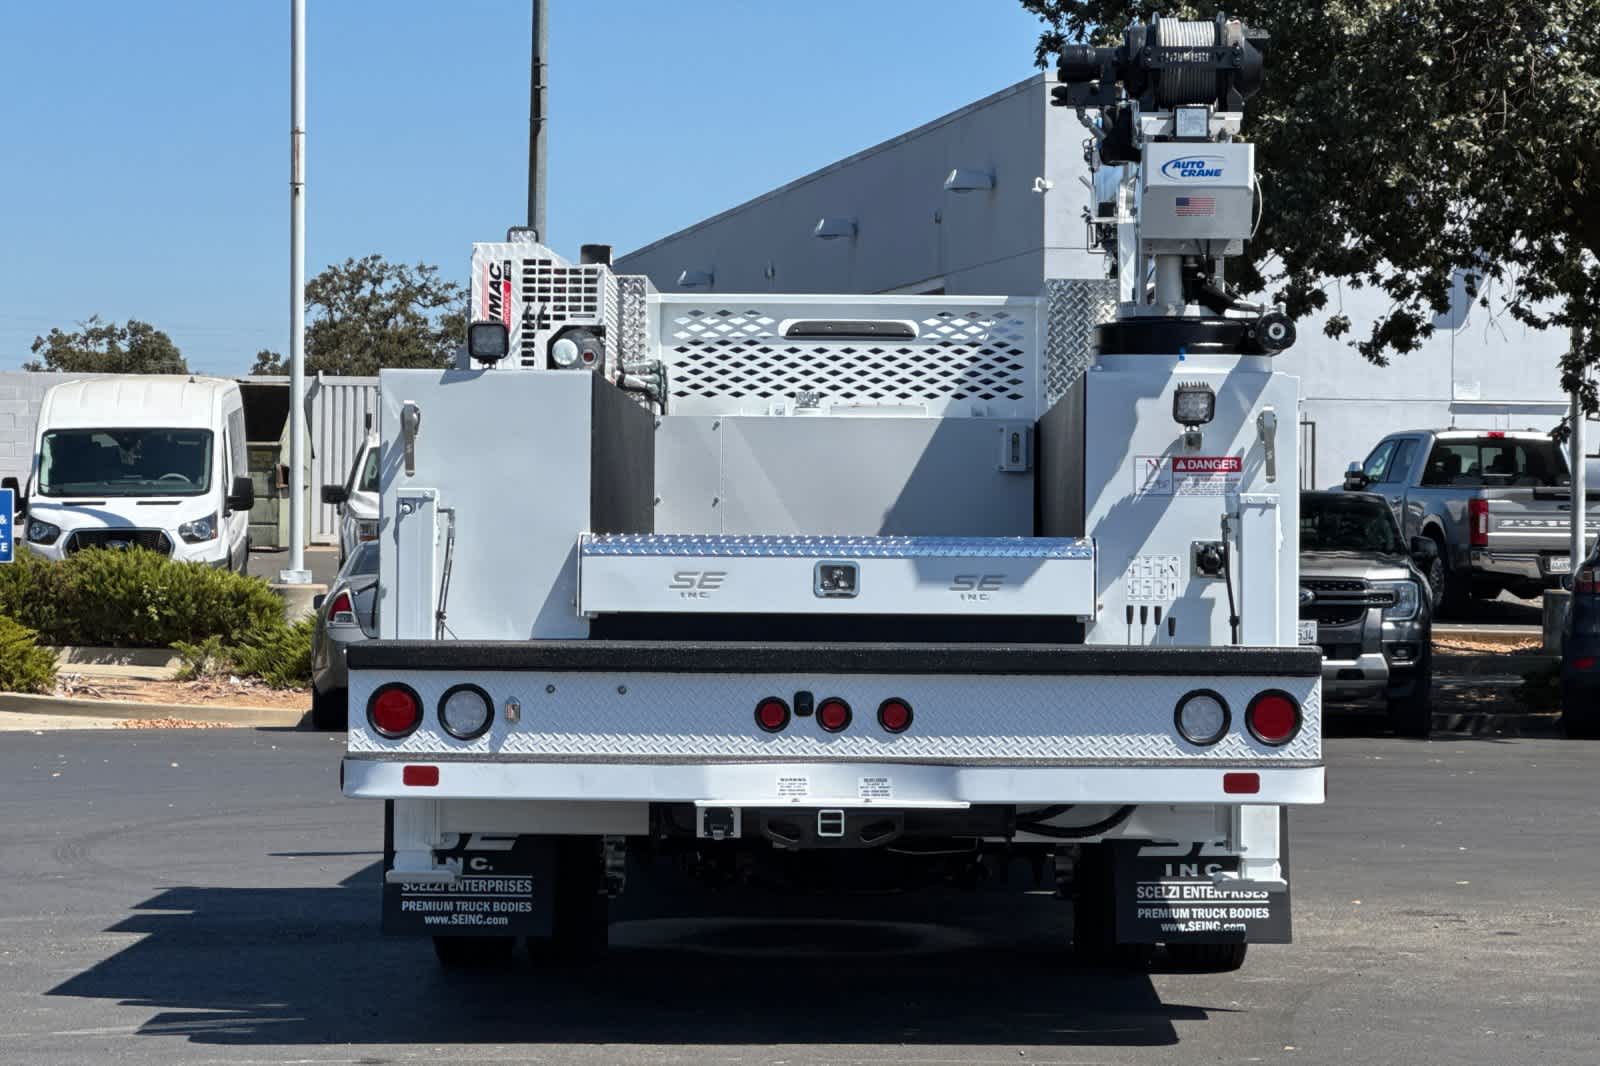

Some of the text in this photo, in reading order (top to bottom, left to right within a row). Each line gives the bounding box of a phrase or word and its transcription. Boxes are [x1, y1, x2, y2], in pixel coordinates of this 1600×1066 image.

[1172, 161, 1205, 169] AUTO
[1180, 169, 1223, 177] CRANE
[1187, 460, 1238, 470] DANGER
[668, 571, 728, 589] SE
[948, 575, 1008, 591] SE
[401, 879, 532, 893] SCELZI ENTERPRISES
[1136, 886, 1180, 899] SCELZI
[401, 901, 532, 912] PREMIUM TRUCK BODIES
[1137, 908, 1270, 919] PREMIUM TRUCK BODIES
[424, 914, 508, 925] www.SEINC.com
[1160, 921, 1246, 932] www.SEINC.com
